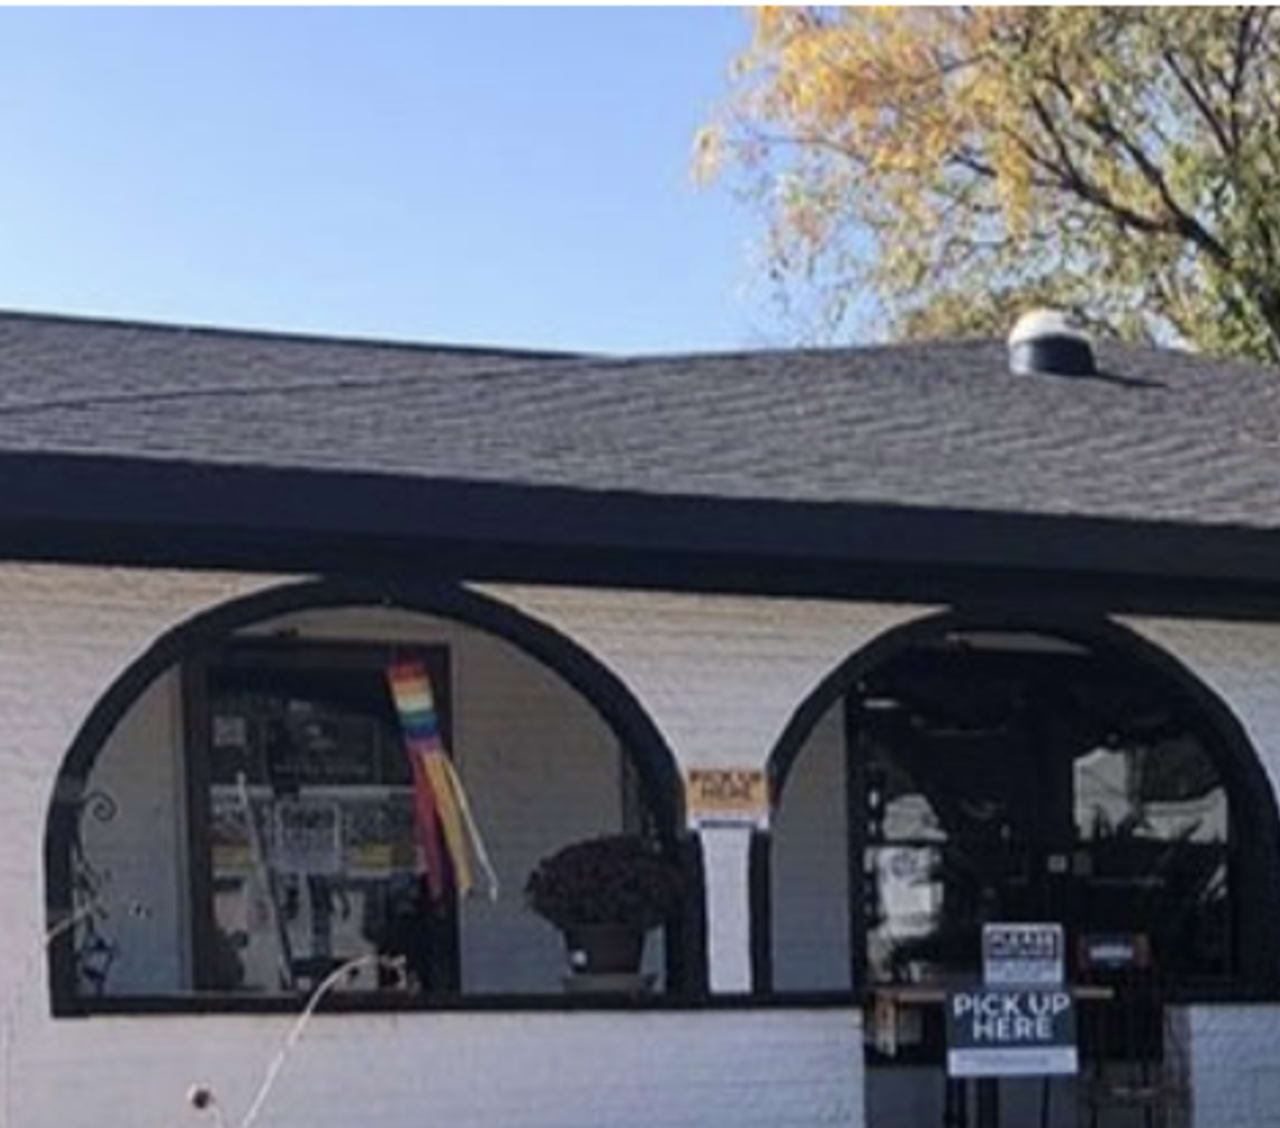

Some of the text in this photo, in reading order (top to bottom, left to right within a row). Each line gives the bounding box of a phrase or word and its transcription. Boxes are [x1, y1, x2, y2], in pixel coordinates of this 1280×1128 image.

[689, 770, 762, 785] PICK UP
[701, 783, 751, 799] HERE
[953, 992, 1071, 1017] PICK UP
[972, 1016, 1053, 1040] HERE
